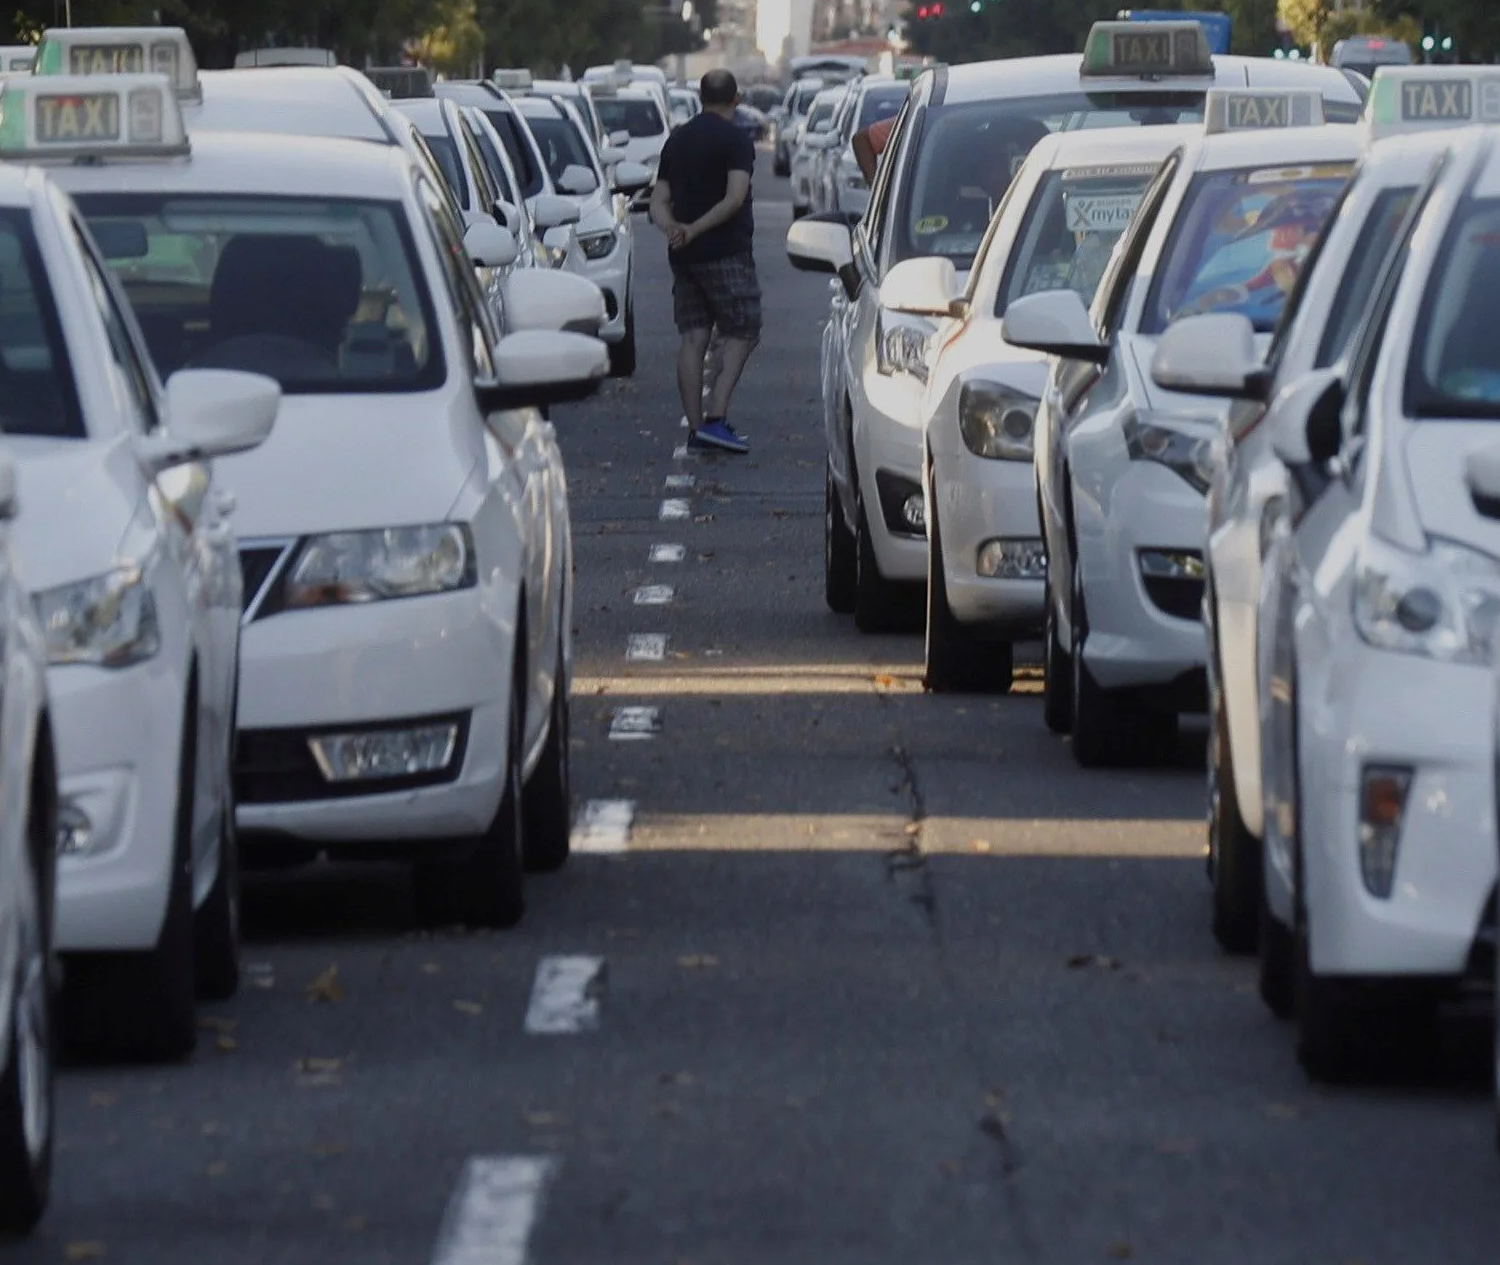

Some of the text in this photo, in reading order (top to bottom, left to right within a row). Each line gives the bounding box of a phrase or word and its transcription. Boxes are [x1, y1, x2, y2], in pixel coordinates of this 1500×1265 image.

[1118, 38, 1169, 62] TAXI
[1231, 98, 1287, 124] TAXI
[1404, 84, 1470, 116] TAXI
[41, 96, 119, 136] TAXI
